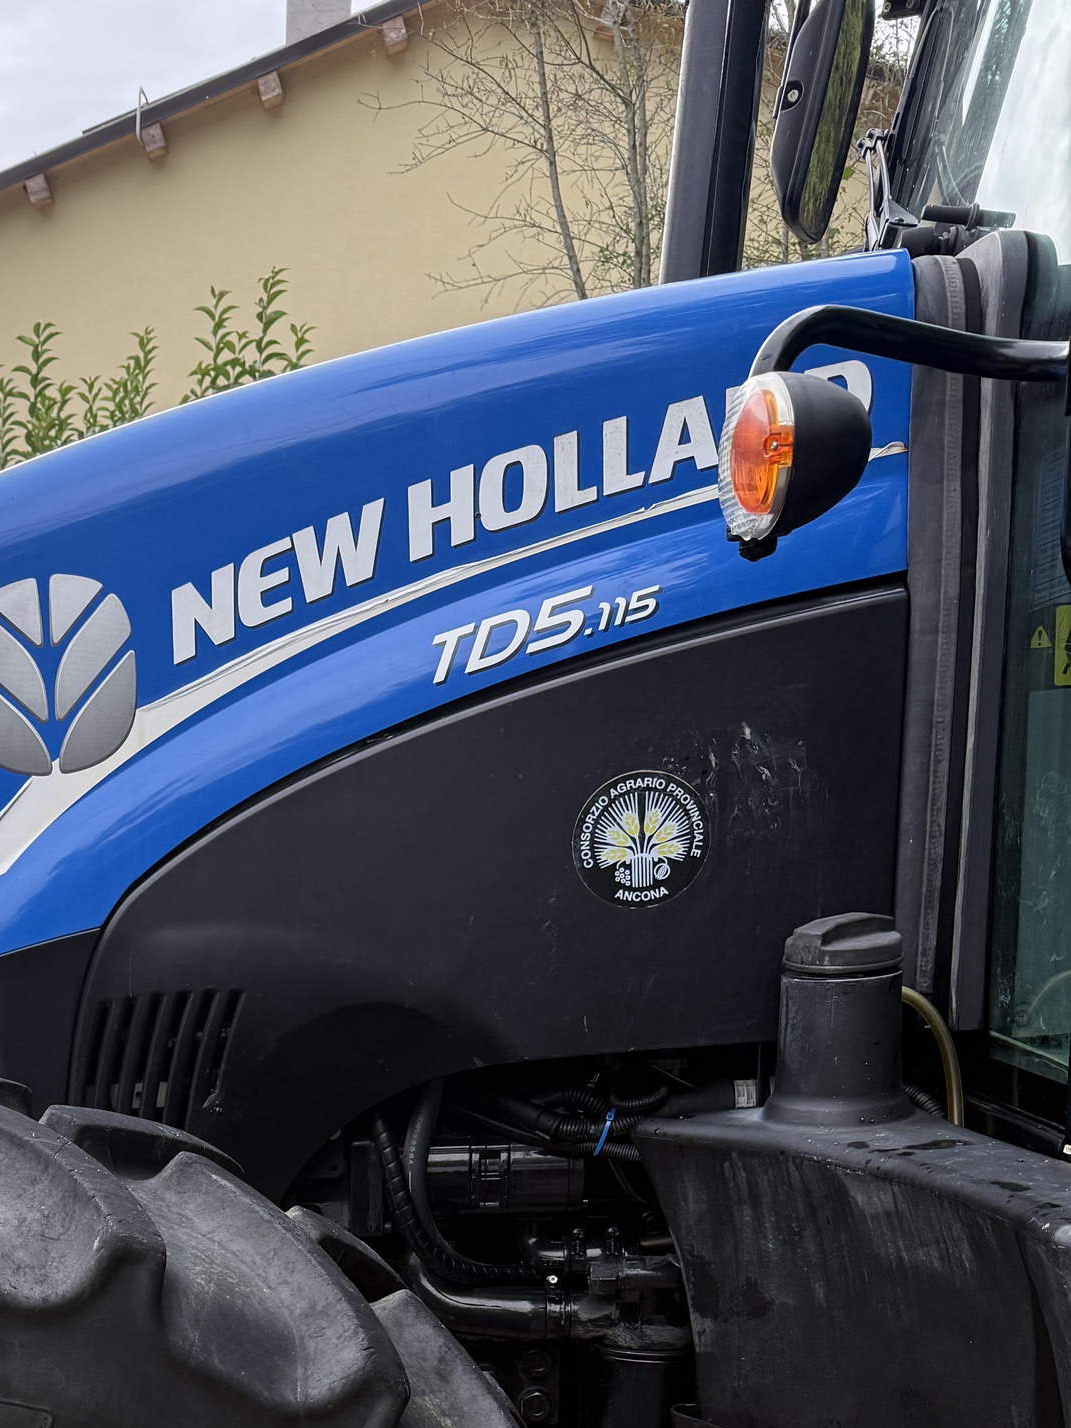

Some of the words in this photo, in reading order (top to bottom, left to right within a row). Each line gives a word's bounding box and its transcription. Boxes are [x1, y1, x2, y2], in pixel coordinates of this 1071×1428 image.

[170, 497, 385, 665] NEW
[406, 360, 872, 563] HOLLAD
[432, 584, 661, 685] TD5.115
[580, 795, 609, 869] CONSORZIO
[609, 777, 666, 800] AGRARIO
[667, 782, 704, 858] PROVINCIALE
[614, 886, 669, 902] ANCONA
